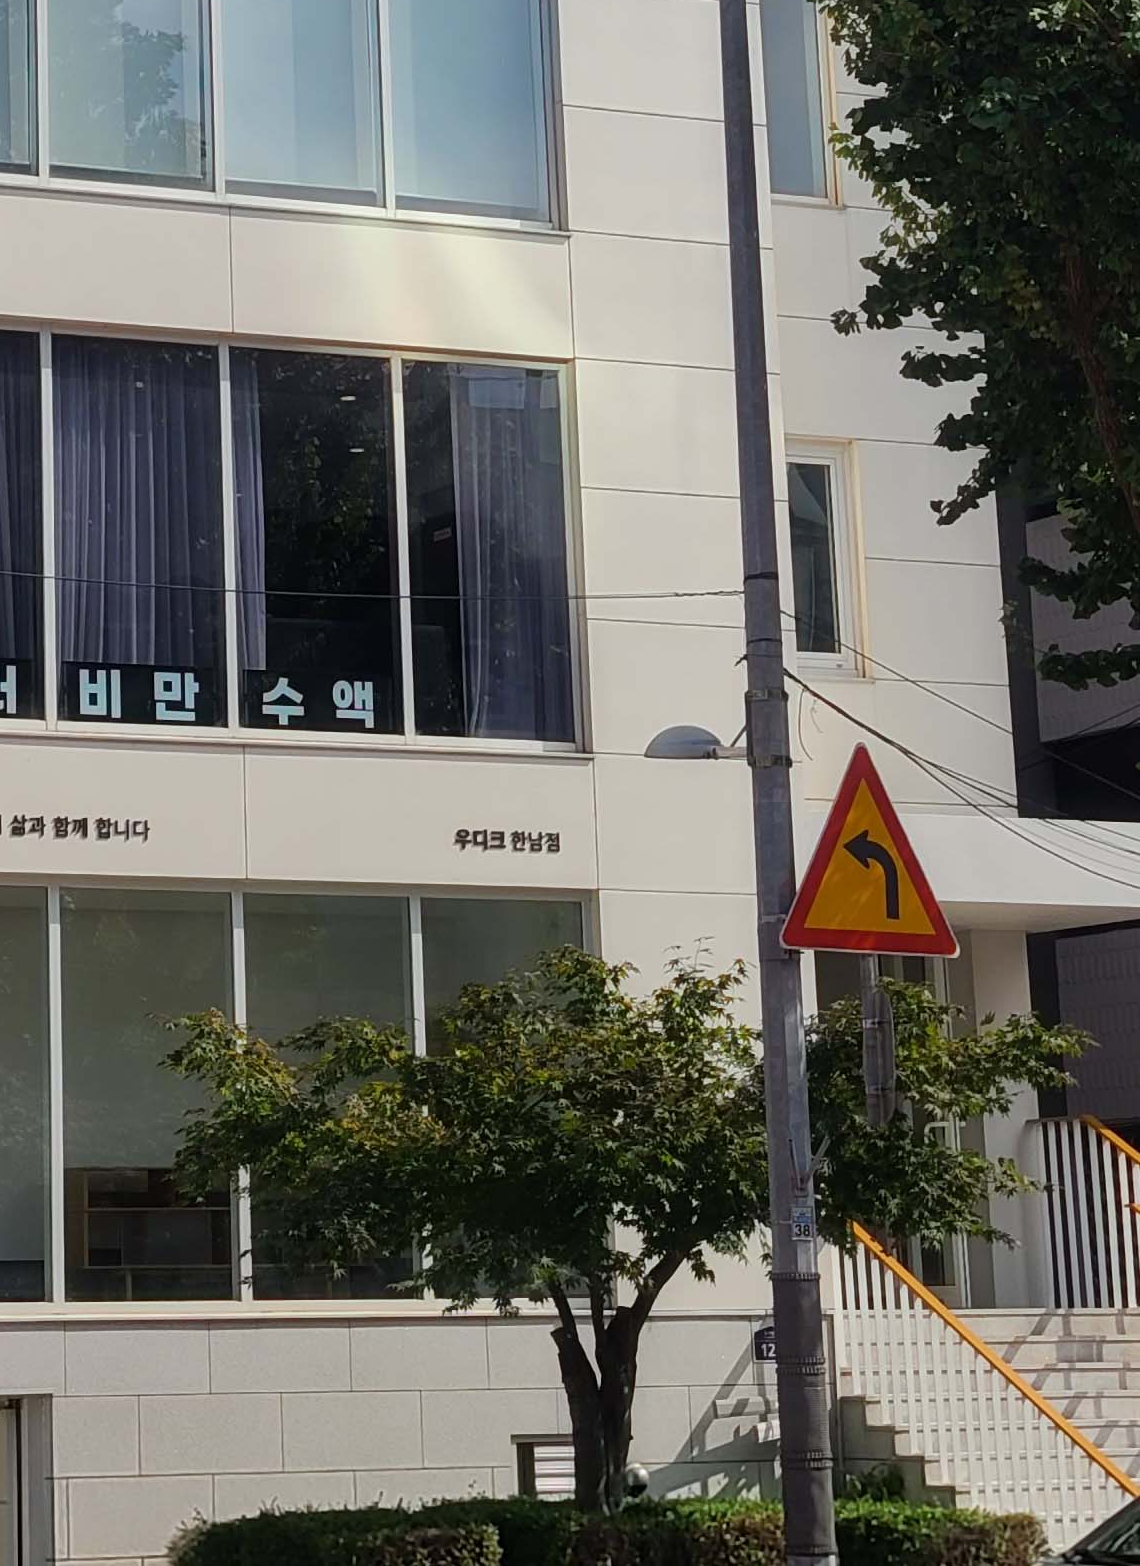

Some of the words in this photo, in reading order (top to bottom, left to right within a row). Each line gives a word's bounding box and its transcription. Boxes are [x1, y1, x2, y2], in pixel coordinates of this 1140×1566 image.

[9, 813, 47, 838] 삶과
[52, 815, 89, 839] 함께
[94, 817, 151, 842] 합니다
[454, 828, 507, 851] 우디크
[510, 830, 561, 853] 한남점
[794, 1224, 811, 1237] 38
